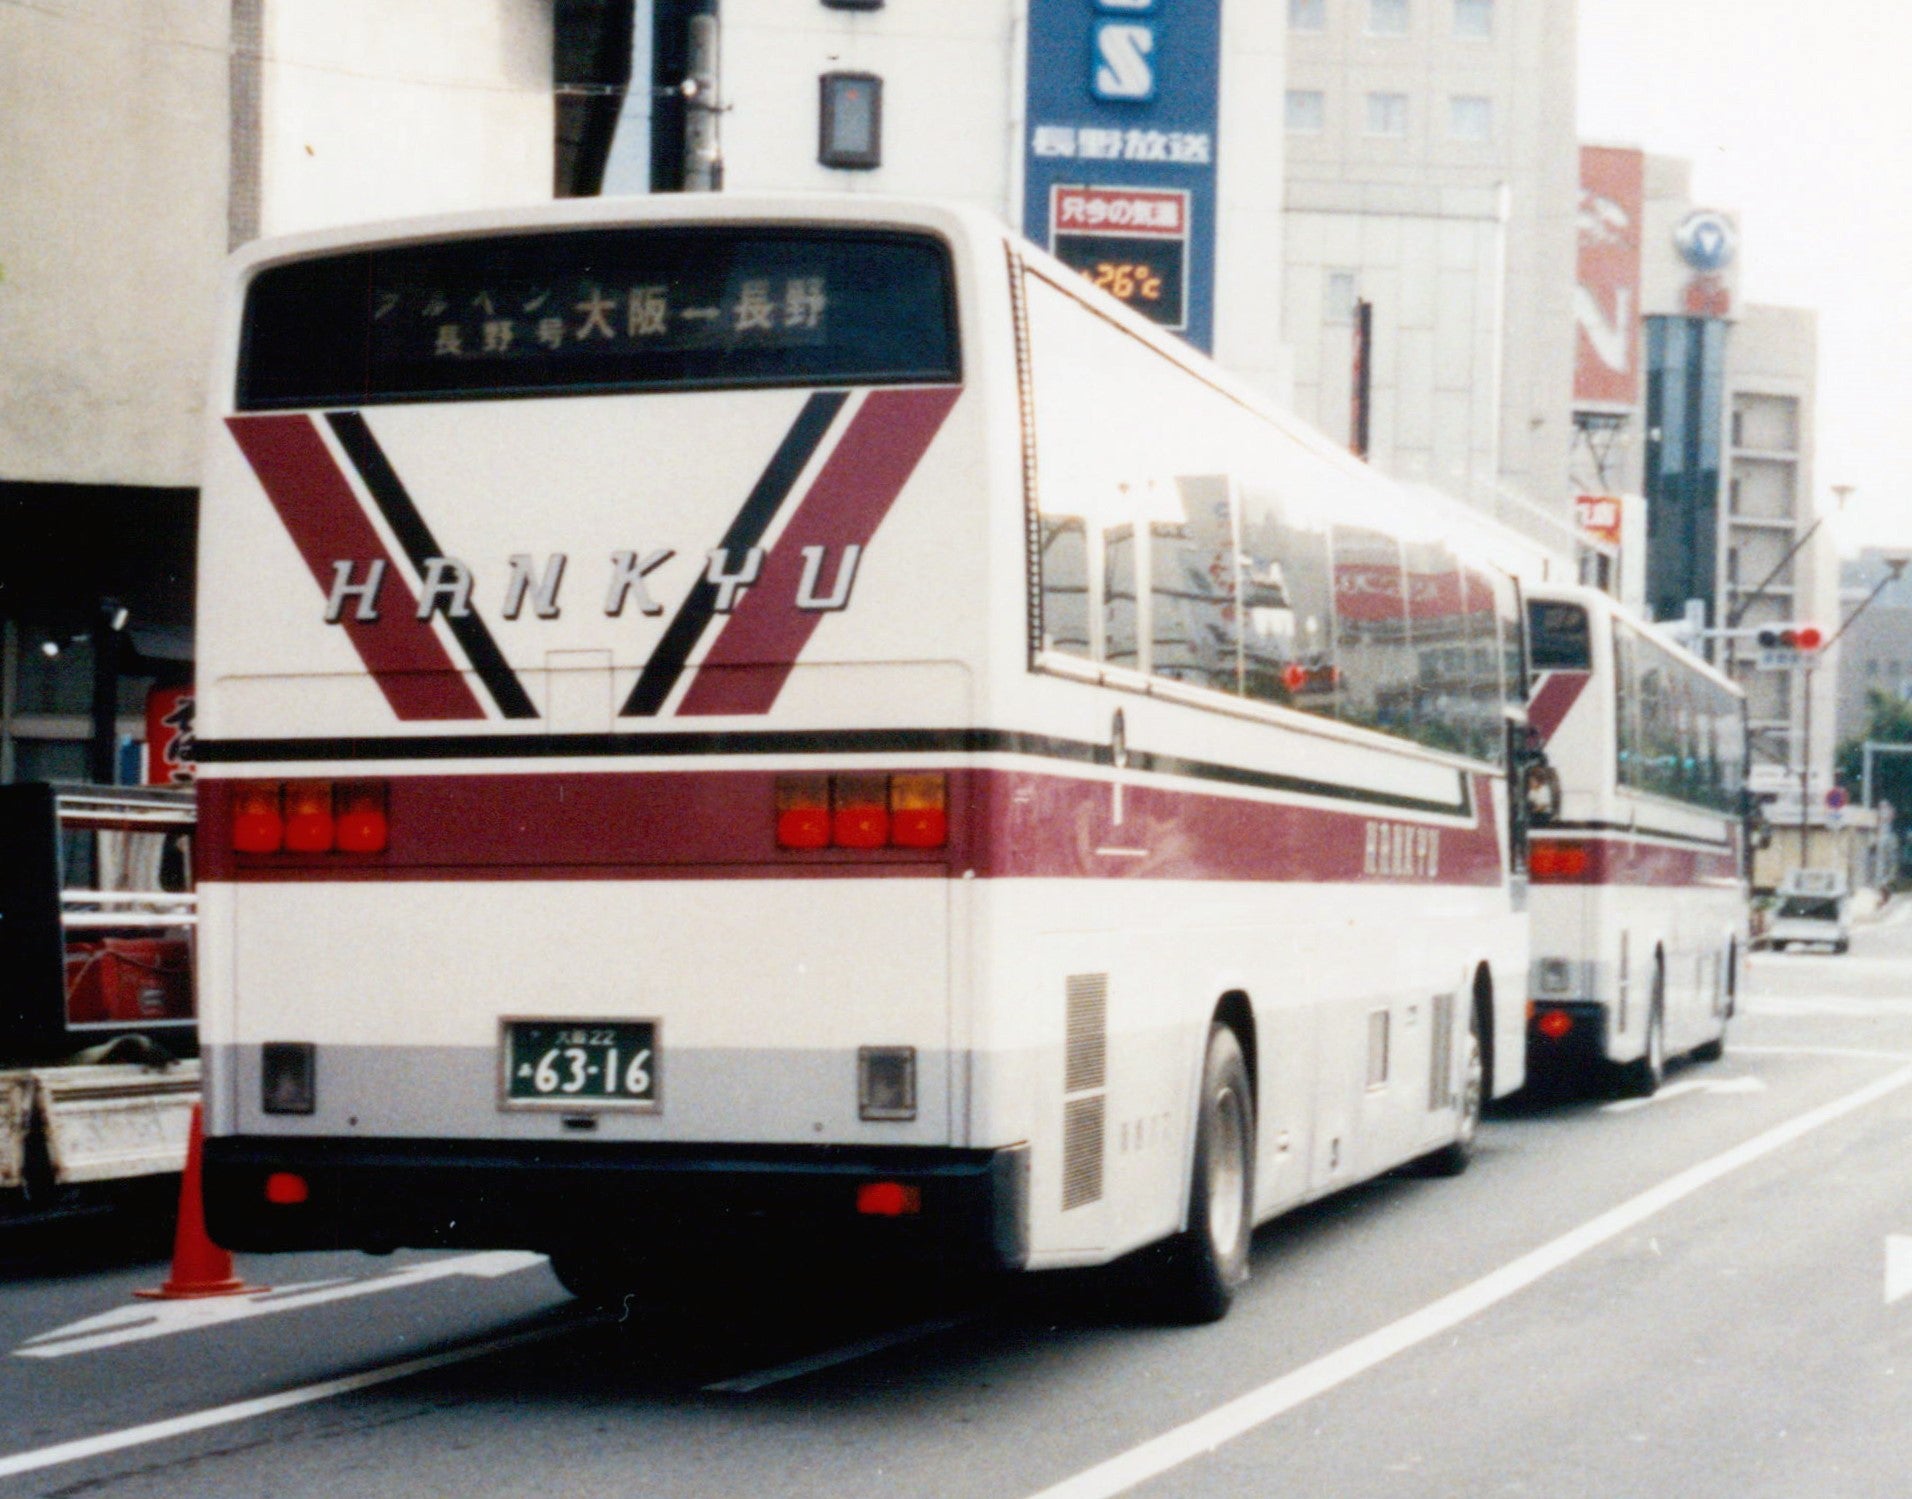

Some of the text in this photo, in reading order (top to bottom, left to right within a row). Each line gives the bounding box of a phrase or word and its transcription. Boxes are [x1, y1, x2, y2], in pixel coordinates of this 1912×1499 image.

[1033, 126, 1209, 164] 長野放送
[434, 317, 565, 355] 長野号
[323, 544, 863, 624] HANKYU
[535, 1047, 651, 1094] 63-16
